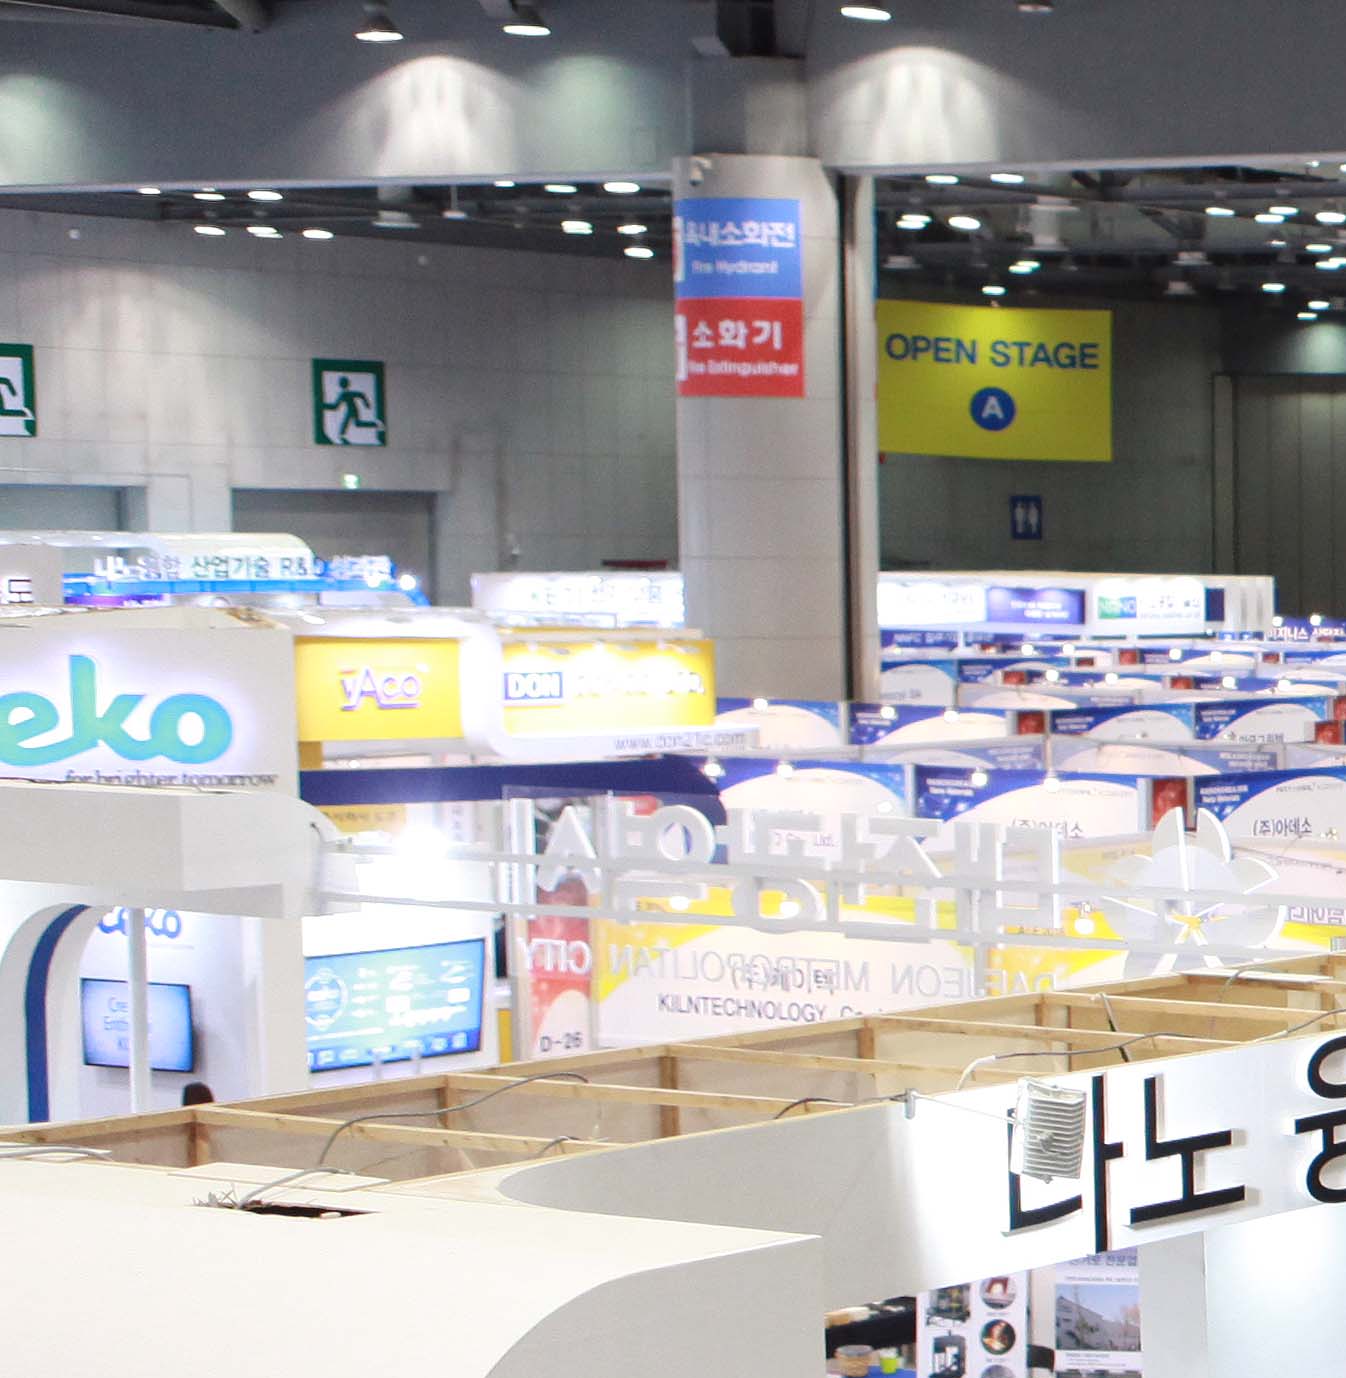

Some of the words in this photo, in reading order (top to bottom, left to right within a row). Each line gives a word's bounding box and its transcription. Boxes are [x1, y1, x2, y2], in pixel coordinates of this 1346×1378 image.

[886, 333, 976, 366] OPEN
[990, 341, 1099, 370] STAGE
[981, 397, 1003, 420] A
[192, 557, 270, 579] 산업기술
[1253, 816, 1312, 837] (주)아데소
[658, 992, 827, 1023] KILNTECHNOLOGY
[540, 1031, 583, 1053] D-26
